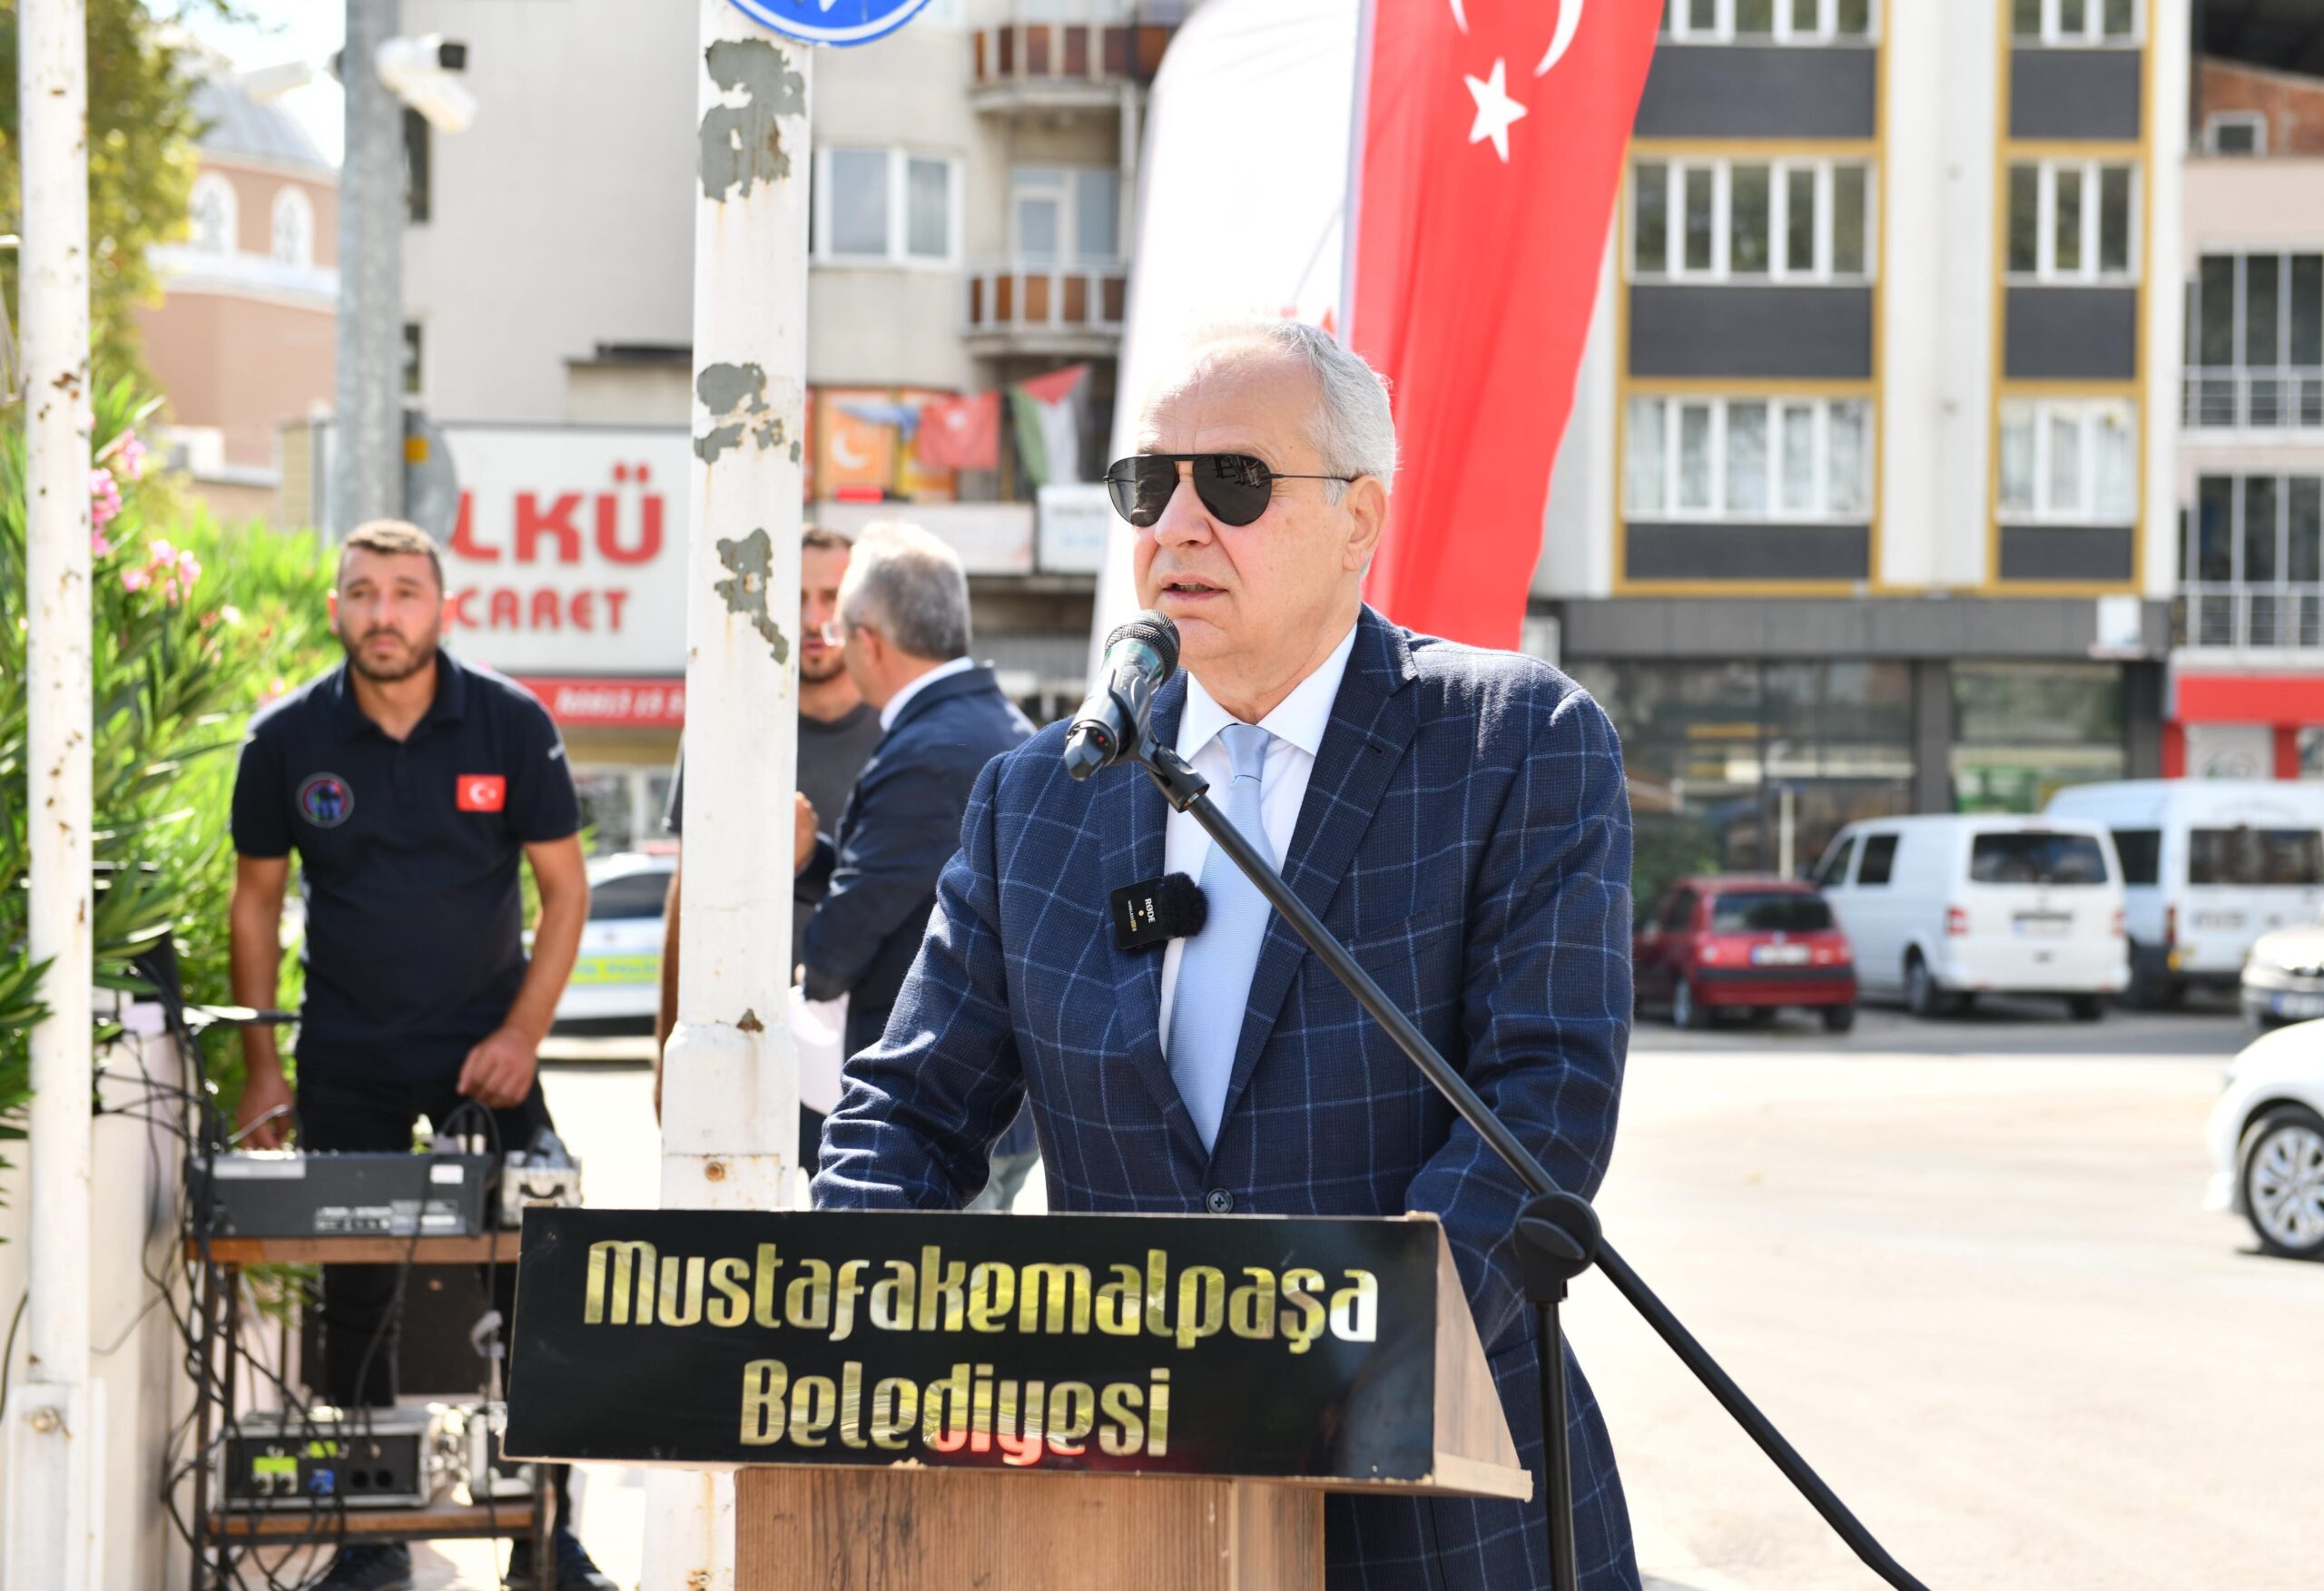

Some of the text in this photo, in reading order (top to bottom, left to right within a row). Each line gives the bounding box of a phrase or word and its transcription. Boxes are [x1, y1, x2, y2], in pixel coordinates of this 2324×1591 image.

[1145, 899, 1156, 924] RØDE
[584, 1240, 1379, 1354] Mustafakemalpaşa
[739, 1358, 1171, 1467] Belediyesi
